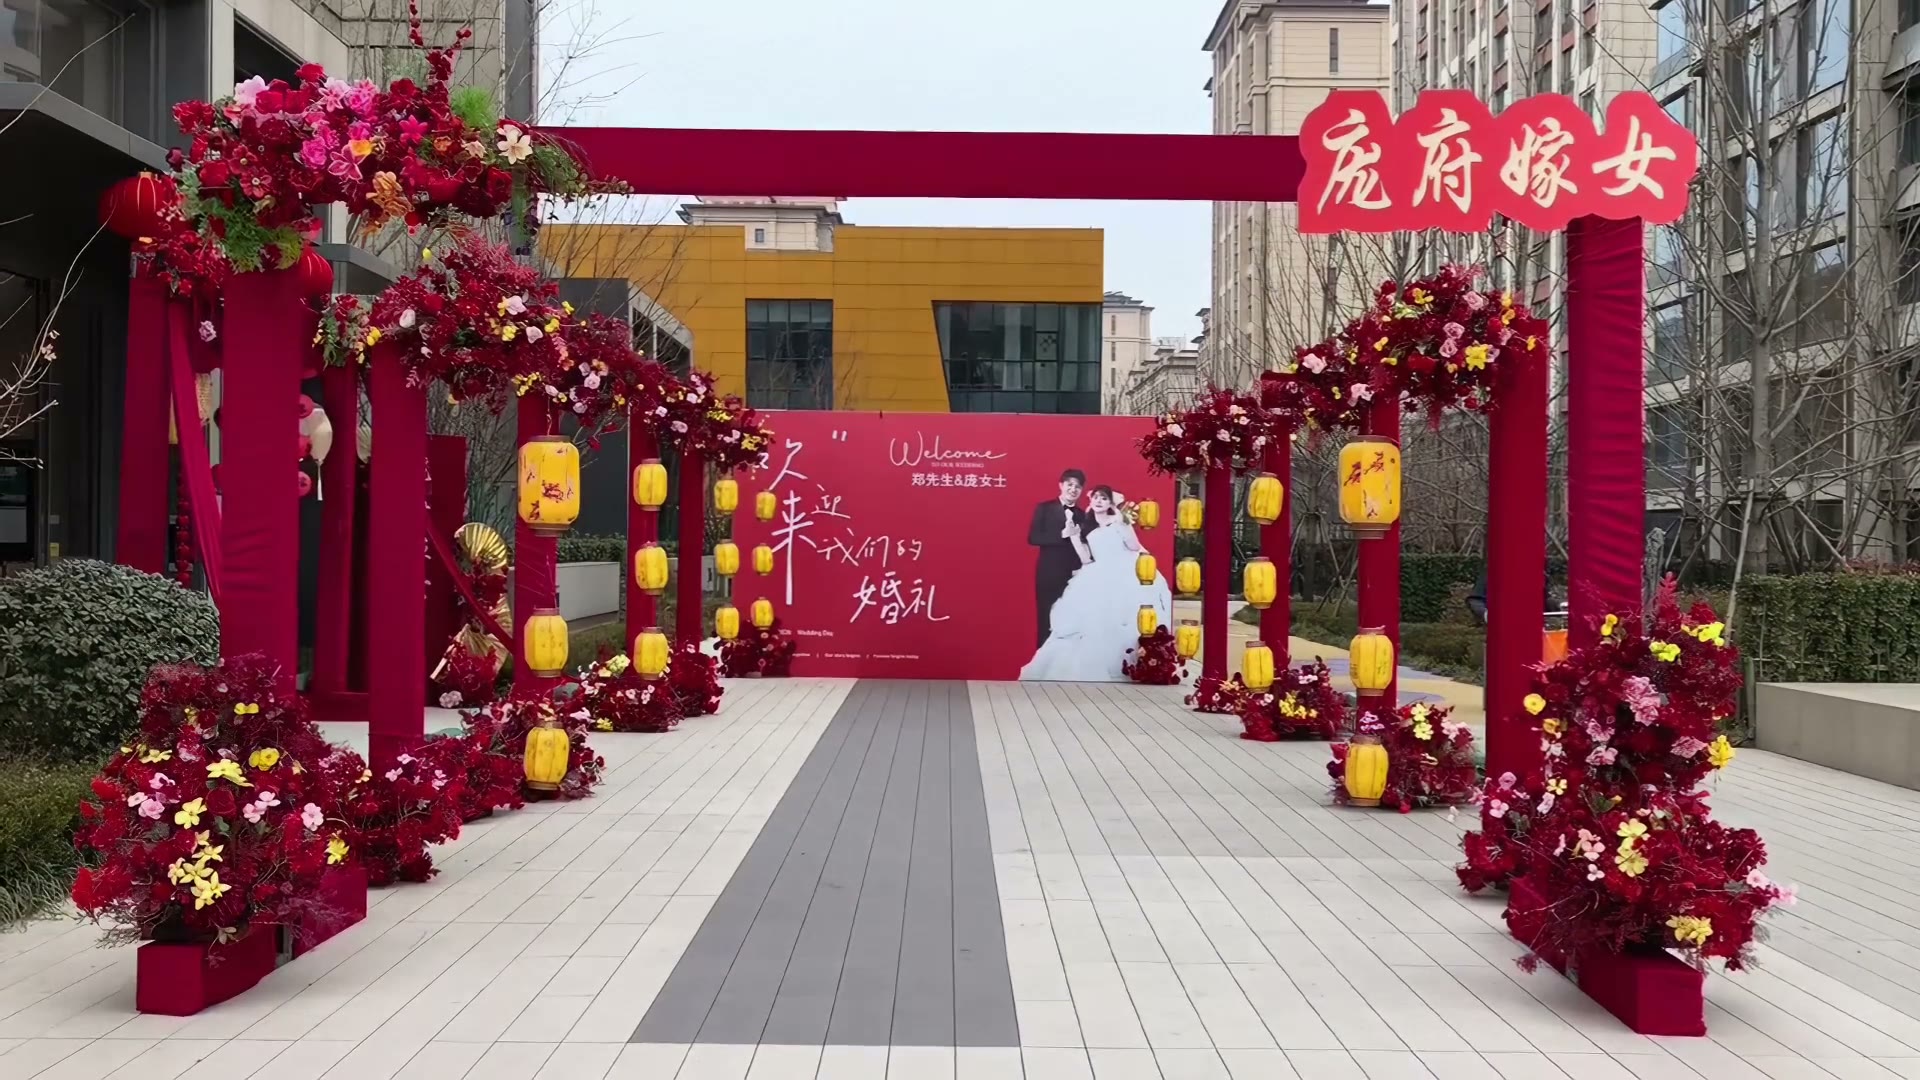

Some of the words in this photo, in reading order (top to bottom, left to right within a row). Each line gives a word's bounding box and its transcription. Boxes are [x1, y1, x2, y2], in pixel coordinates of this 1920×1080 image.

[1316, 107, 1677, 214] 庞府嫁女
[890, 431, 1007, 466] Welcome
[911, 473, 1007, 488] 郑先生&庞女士
[850, 571, 950, 625] 婚礼
